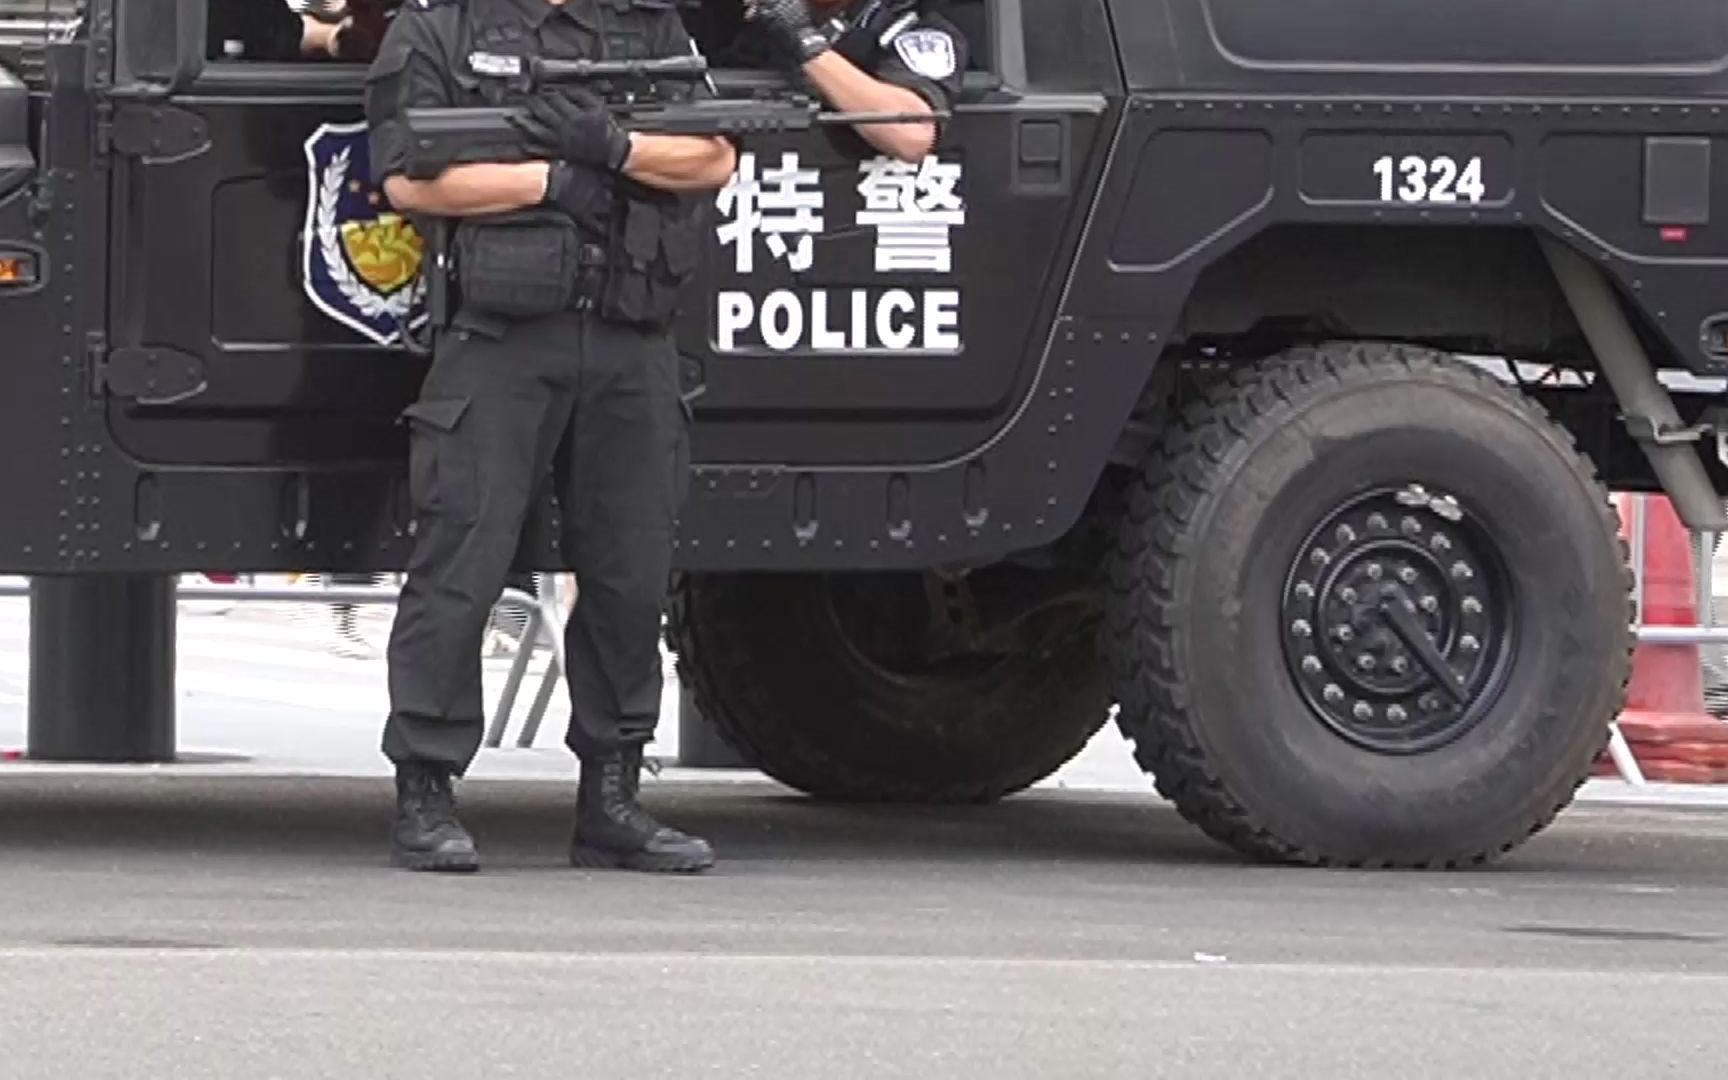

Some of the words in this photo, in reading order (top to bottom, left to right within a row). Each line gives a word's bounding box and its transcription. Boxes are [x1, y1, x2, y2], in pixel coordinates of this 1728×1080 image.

[1373, 155, 1485, 203] 1324
[715, 151, 965, 272] 特警
[718, 288, 960, 350] POLICE
